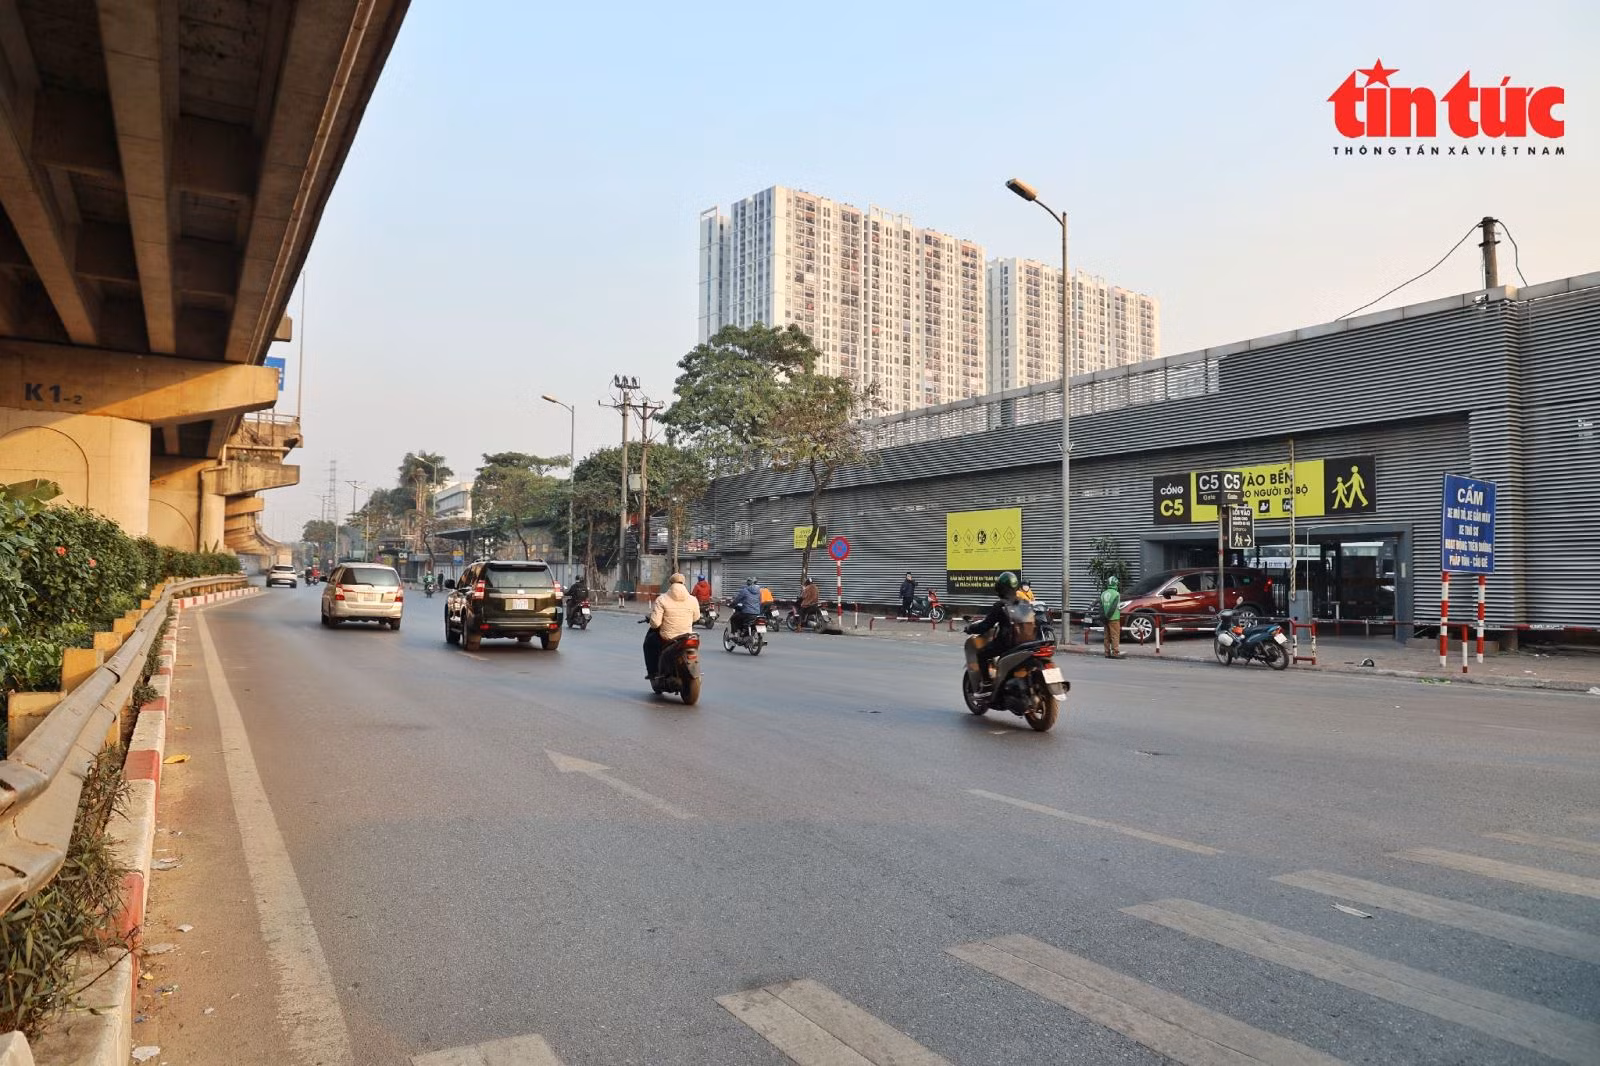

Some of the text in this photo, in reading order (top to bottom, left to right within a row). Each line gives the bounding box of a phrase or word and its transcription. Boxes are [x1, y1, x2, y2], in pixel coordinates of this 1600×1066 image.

[1160, 482, 1184, 495] CỔNG
[1199, 475, 1219, 490] C5
[1223, 473, 1240, 490] C5
[1253, 485, 1282, 498] NGƯỜI
[1296, 484, 1308, 496] BỘ
[1457, 484, 1484, 506] CẤM
[1160, 498, 1184, 517] C5
